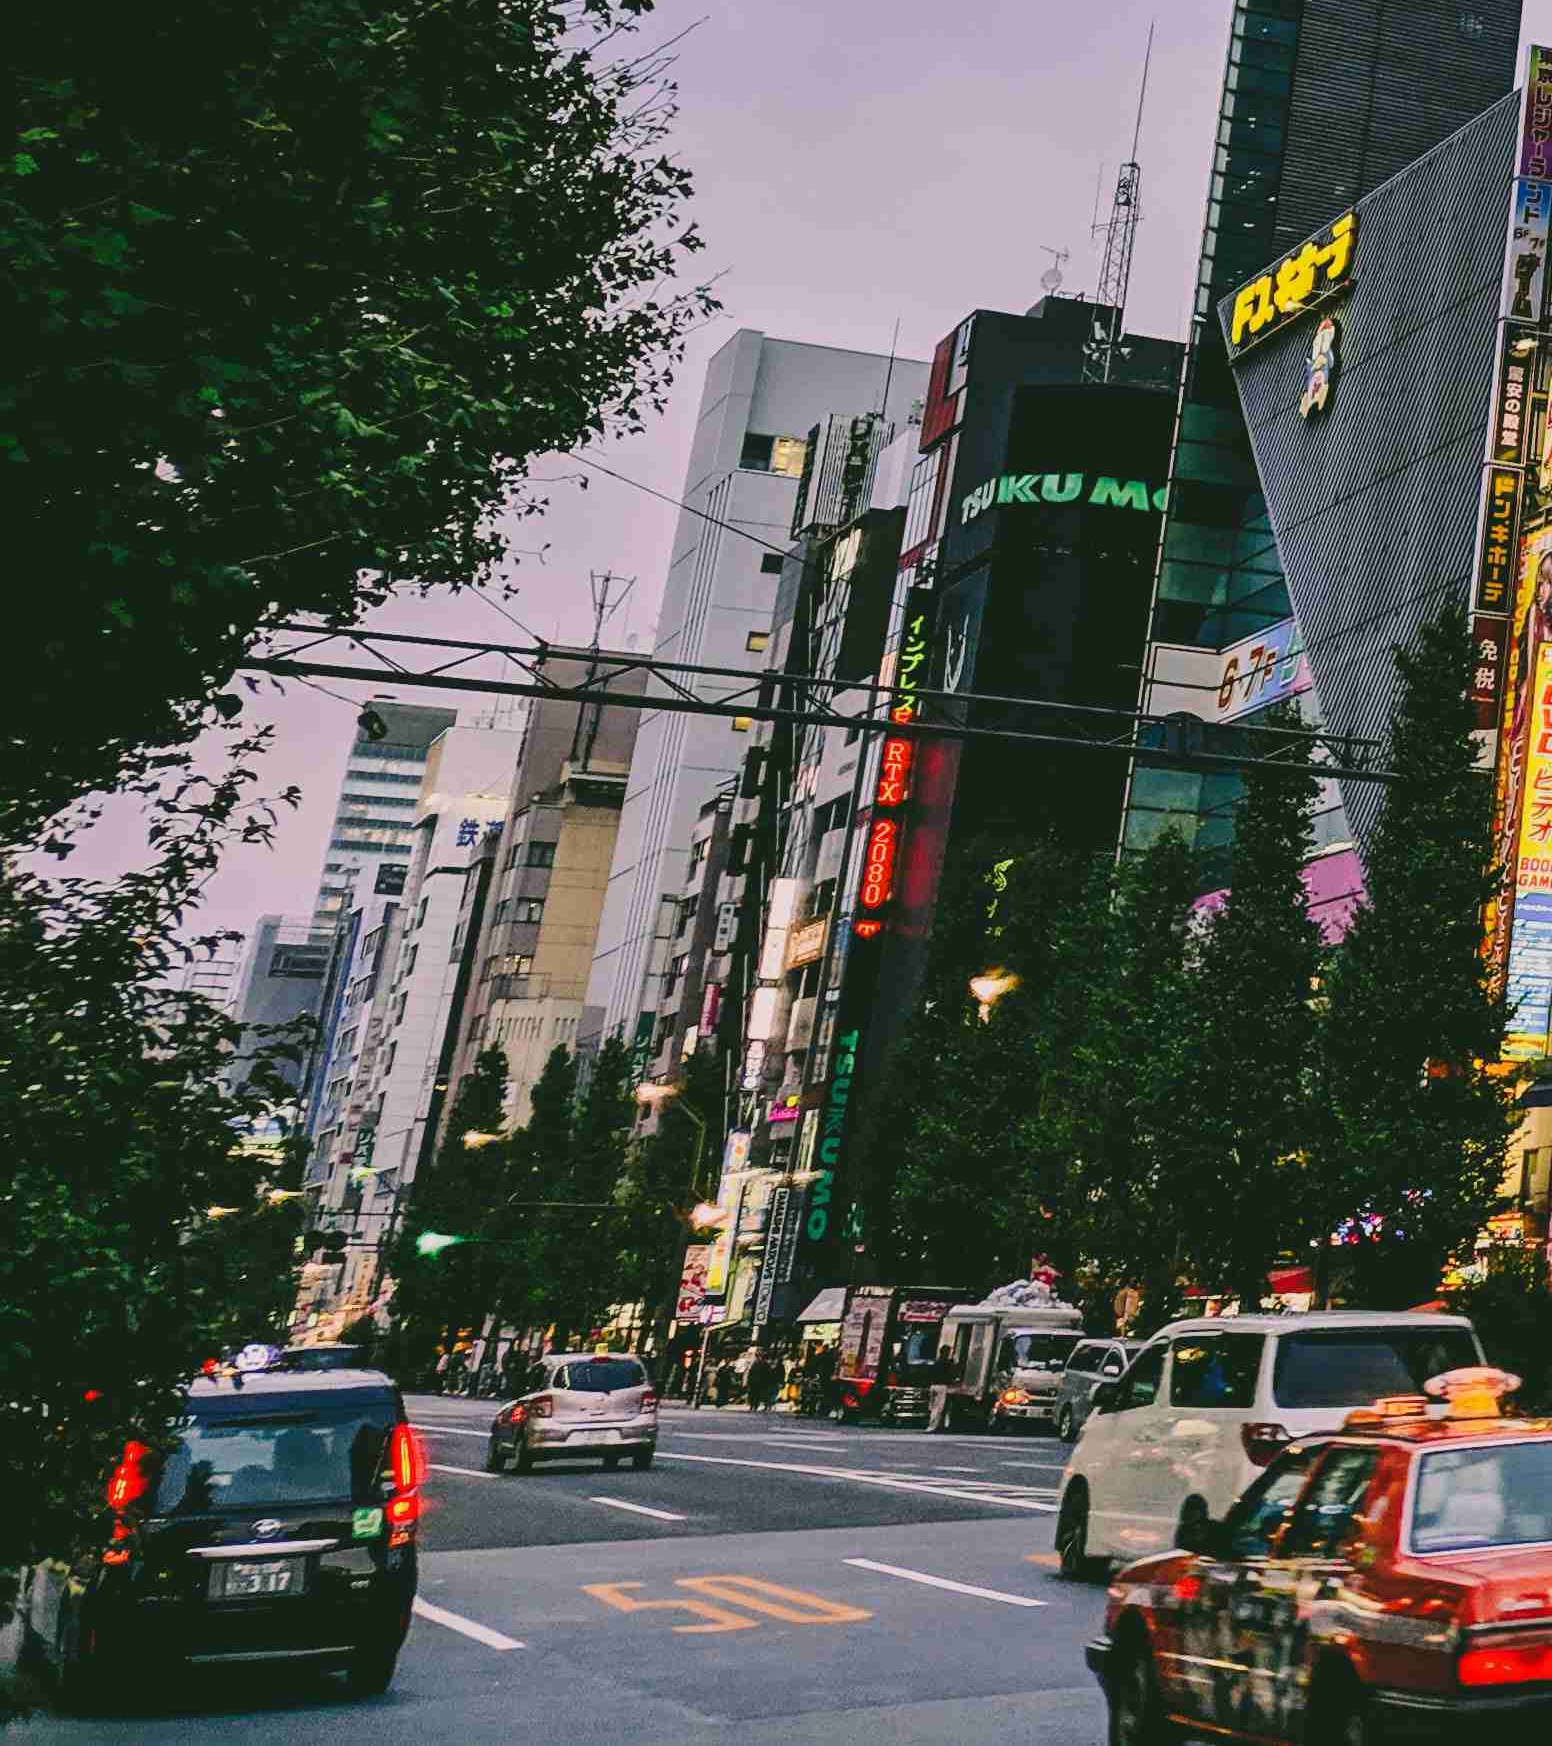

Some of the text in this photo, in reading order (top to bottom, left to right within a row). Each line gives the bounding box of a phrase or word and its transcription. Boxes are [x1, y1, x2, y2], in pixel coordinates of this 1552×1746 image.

[1474, 638, 1497, 692] 免税
[878, 741, 911, 805] RTX
[861, 821, 897, 908] 2080
[807, 1029, 860, 1242] TSUKUMO
[579, 1582, 876, 1634] 50
